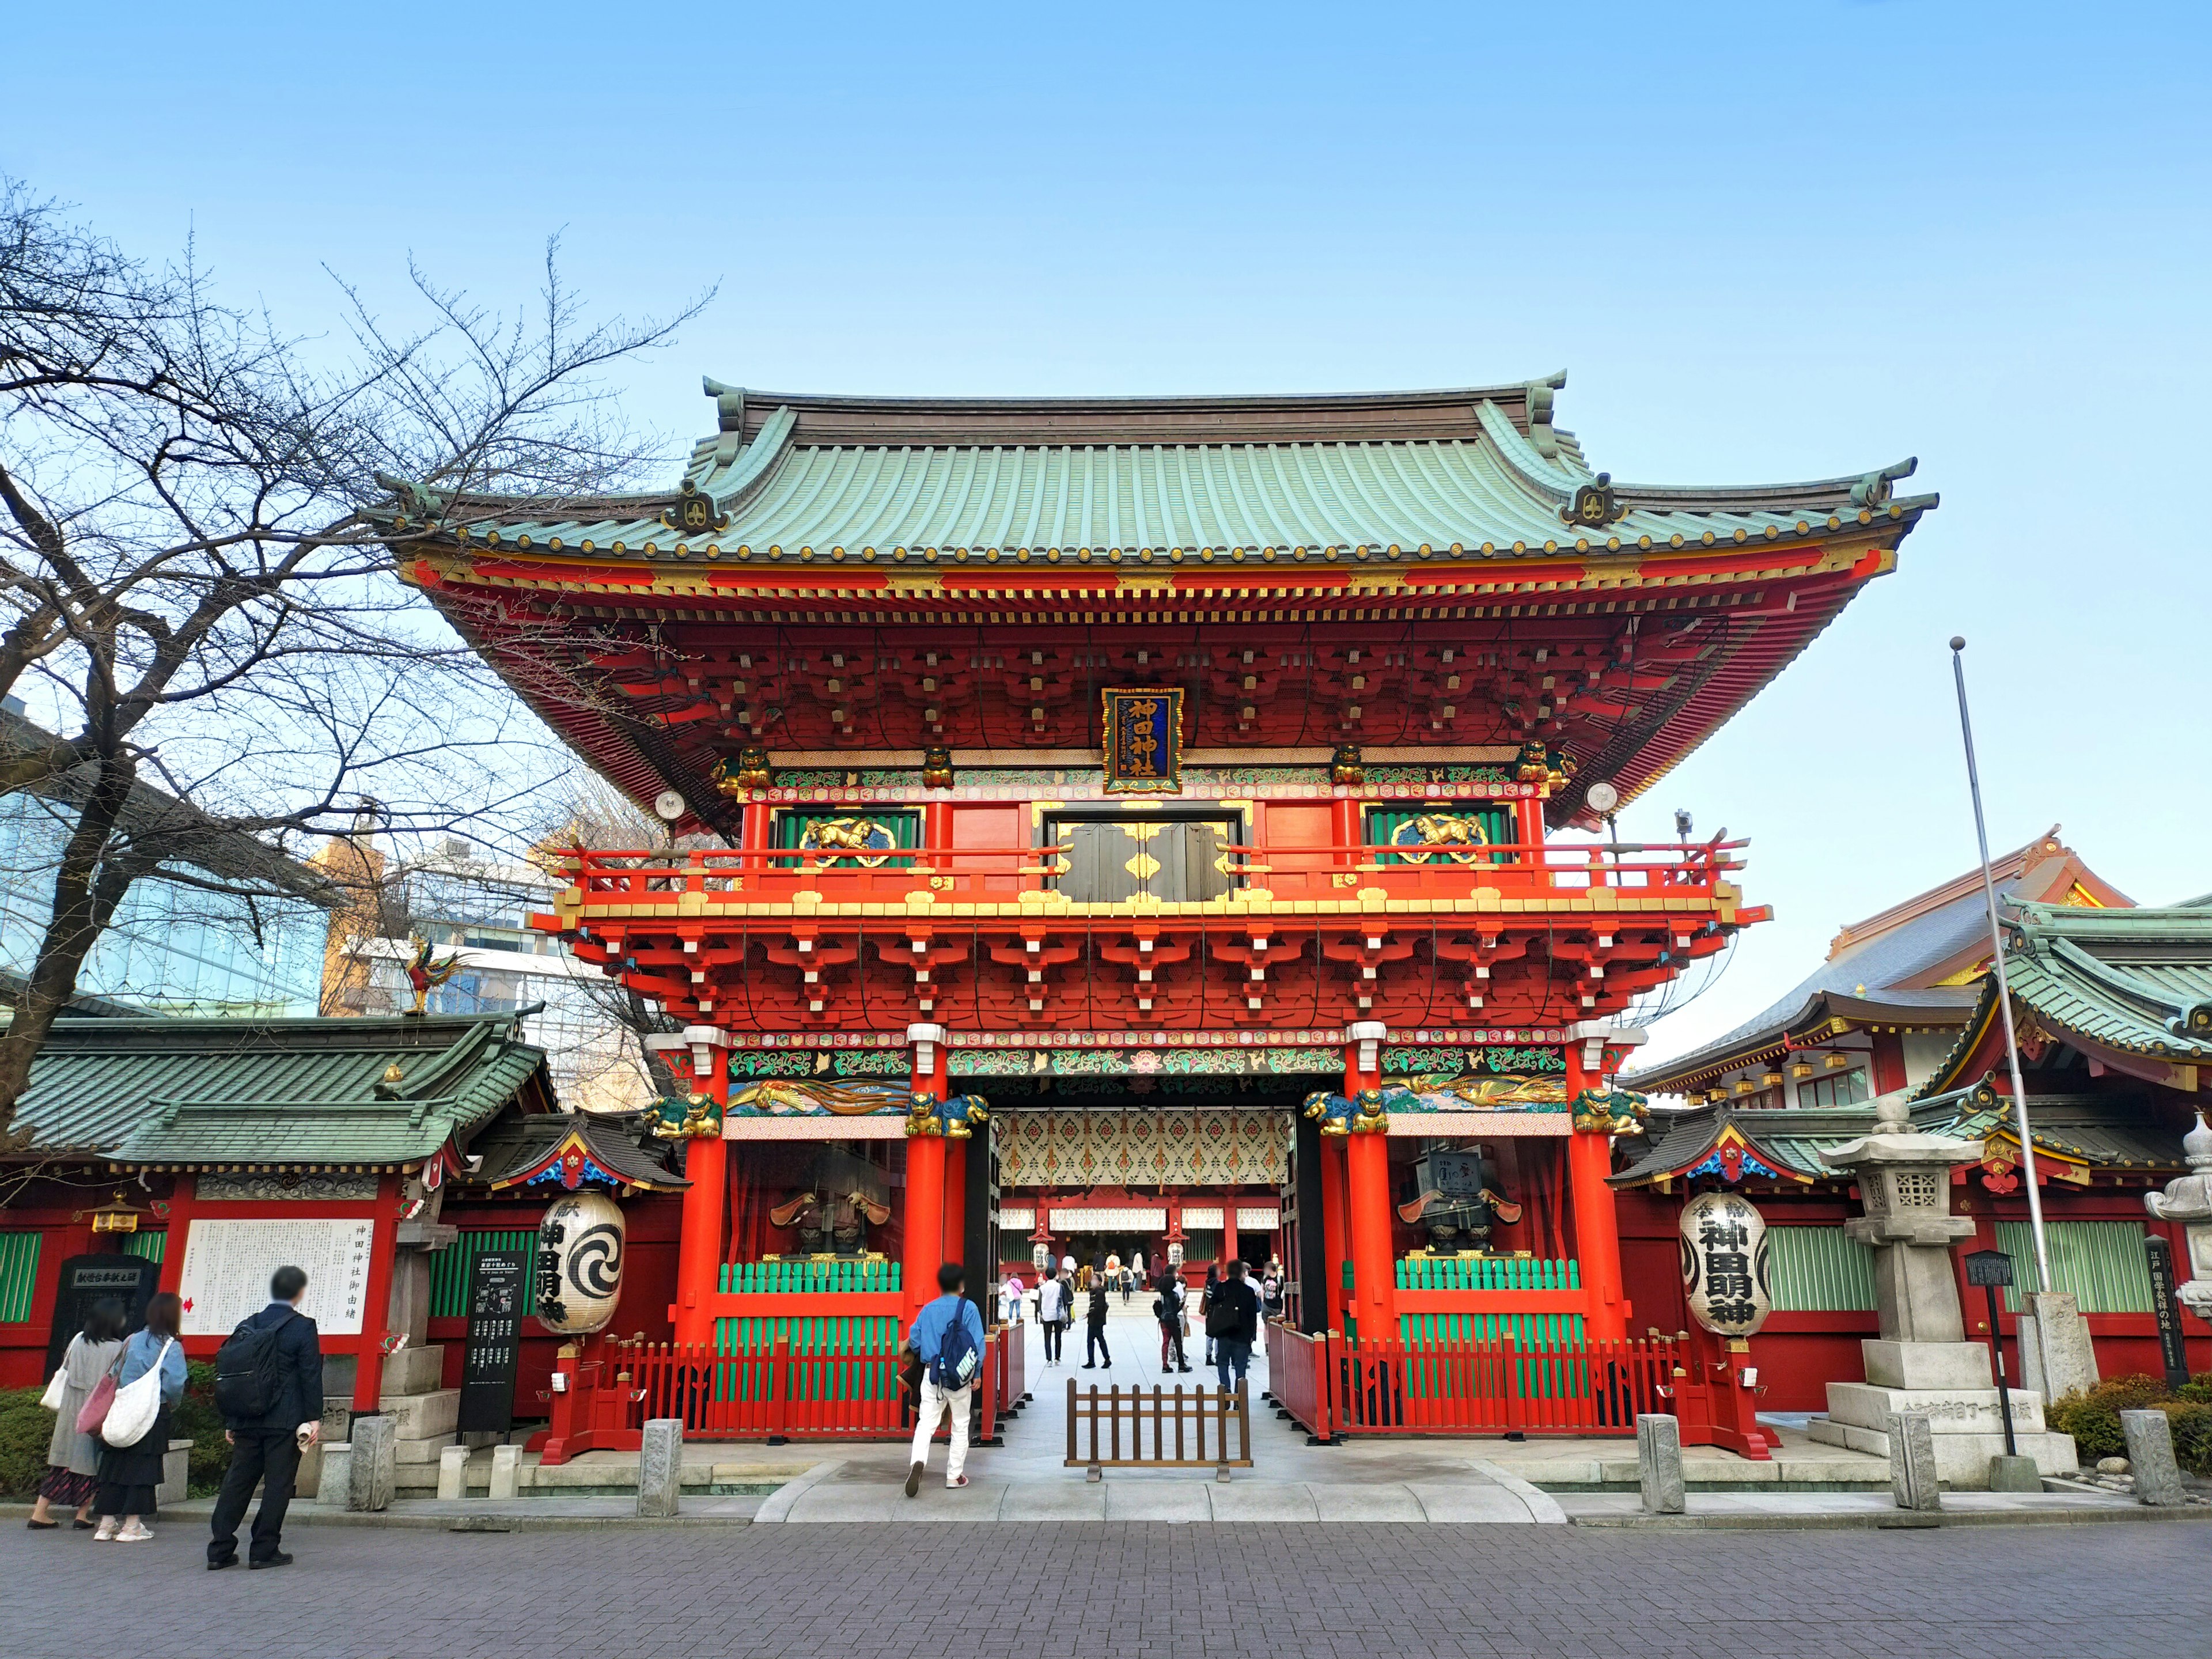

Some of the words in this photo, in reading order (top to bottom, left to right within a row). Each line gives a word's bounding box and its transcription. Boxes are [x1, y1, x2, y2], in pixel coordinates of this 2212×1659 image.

[1128, 698, 1158, 777] 神田神社
[345, 1225, 366, 1319] 神田神社御由緒
[536, 1218, 569, 1323] 神田明神
[1698, 1219, 1758, 1324] 神田明神
[2150, 1251, 2160, 1269] 江戸
[2153, 1272, 2172, 1330] 国学発祥の地
[956, 1346, 978, 1381] NIKE
